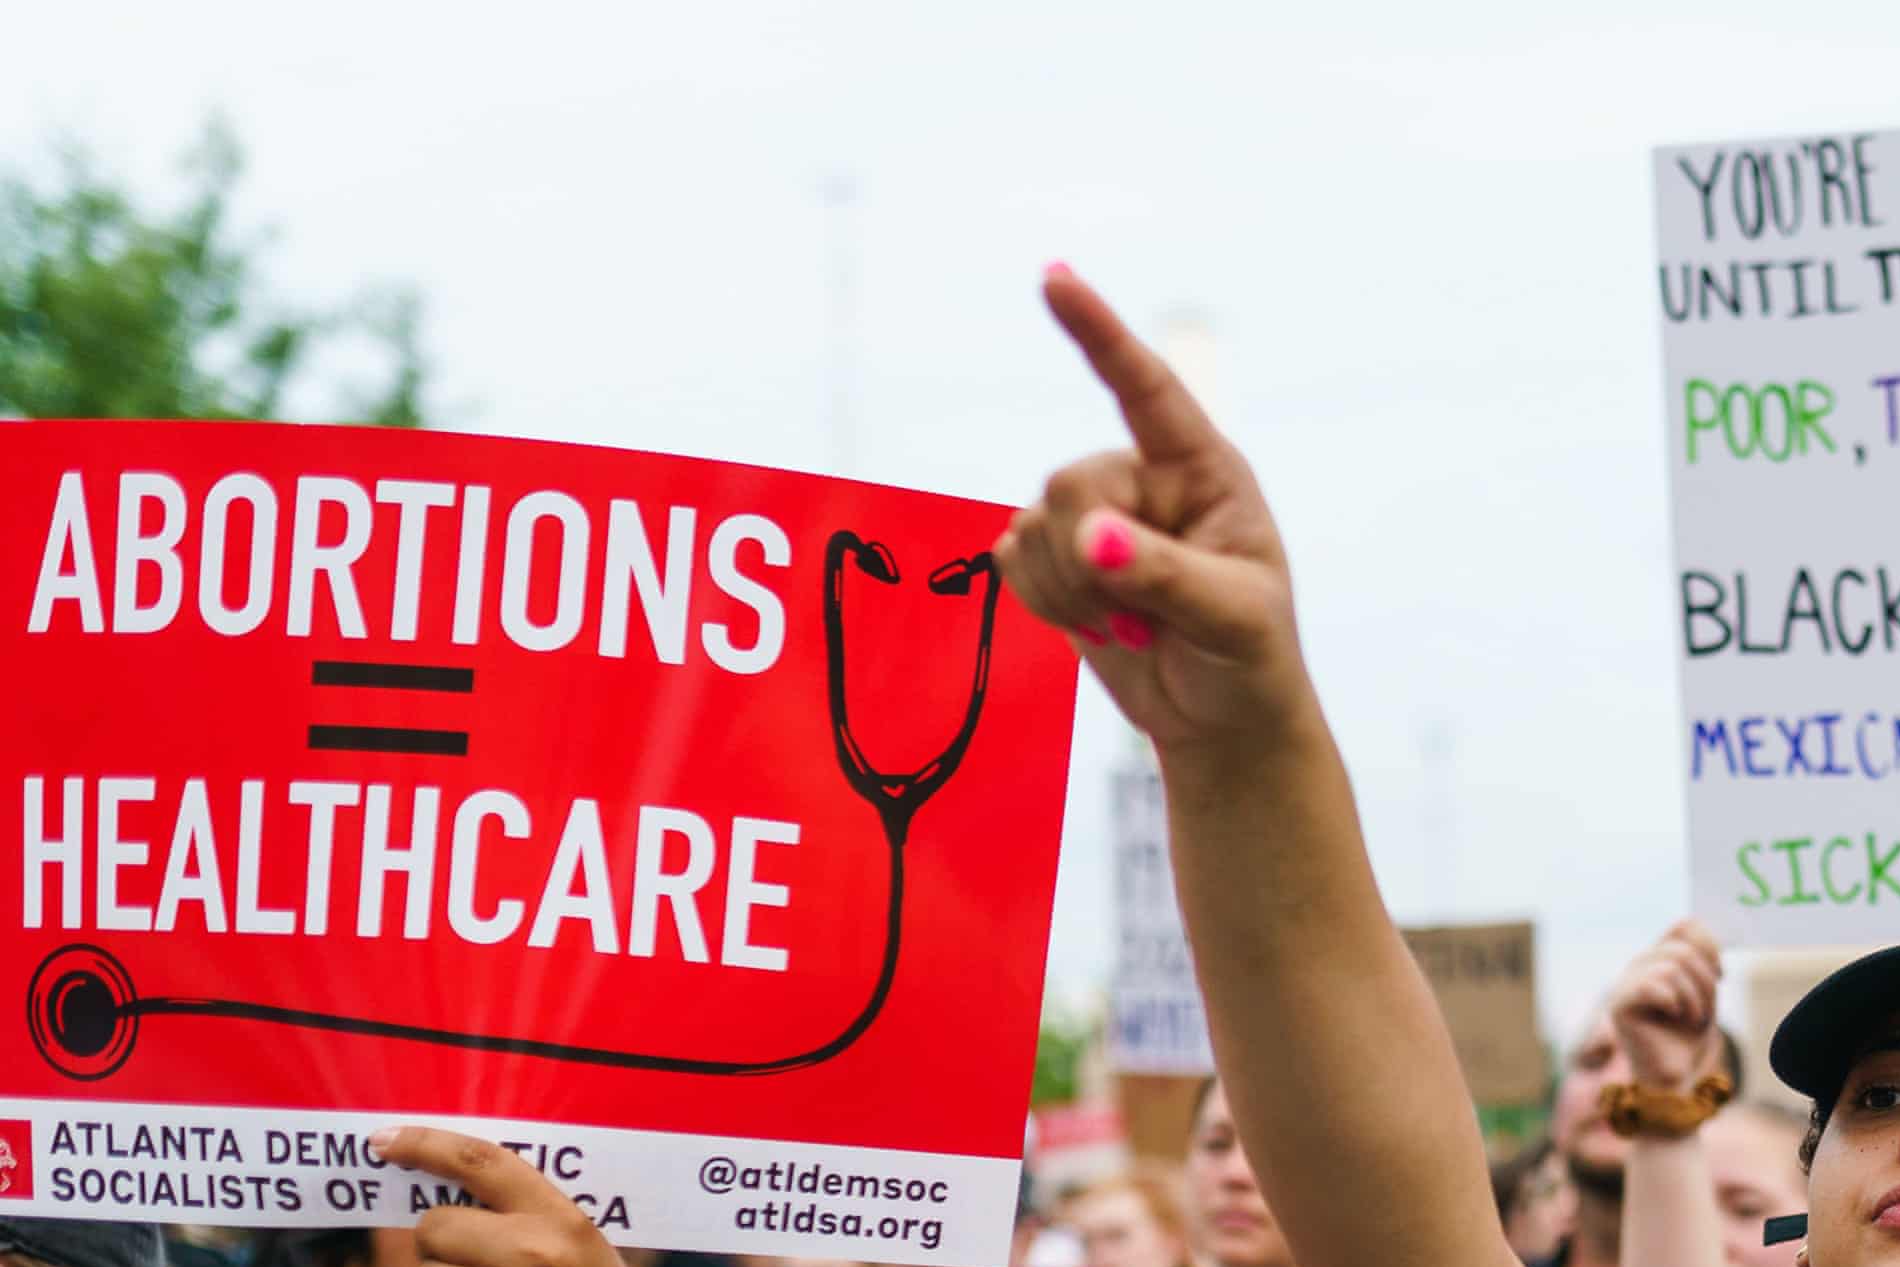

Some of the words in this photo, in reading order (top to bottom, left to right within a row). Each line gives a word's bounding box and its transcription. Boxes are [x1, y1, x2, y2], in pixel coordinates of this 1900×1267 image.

[1679, 134, 1884, 241] YOU'RE
[1659, 258, 1858, 321] UNTIL
[28, 470, 791, 674] ABORTIONS
[23, 776, 801, 971] HEALTHCARE
[50, 1121, 243, 1163] ATLANTA
[266, 1130, 584, 1180] DEMOTIC
[698, 1154, 949, 1204] @atldemsoc
[51, 1168, 302, 1211] SOCIALISTS
[324, 1178, 382, 1212] OF
[409, 1184, 632, 1230] AMCA
[734, 1200, 945, 1250] atldsa.org
